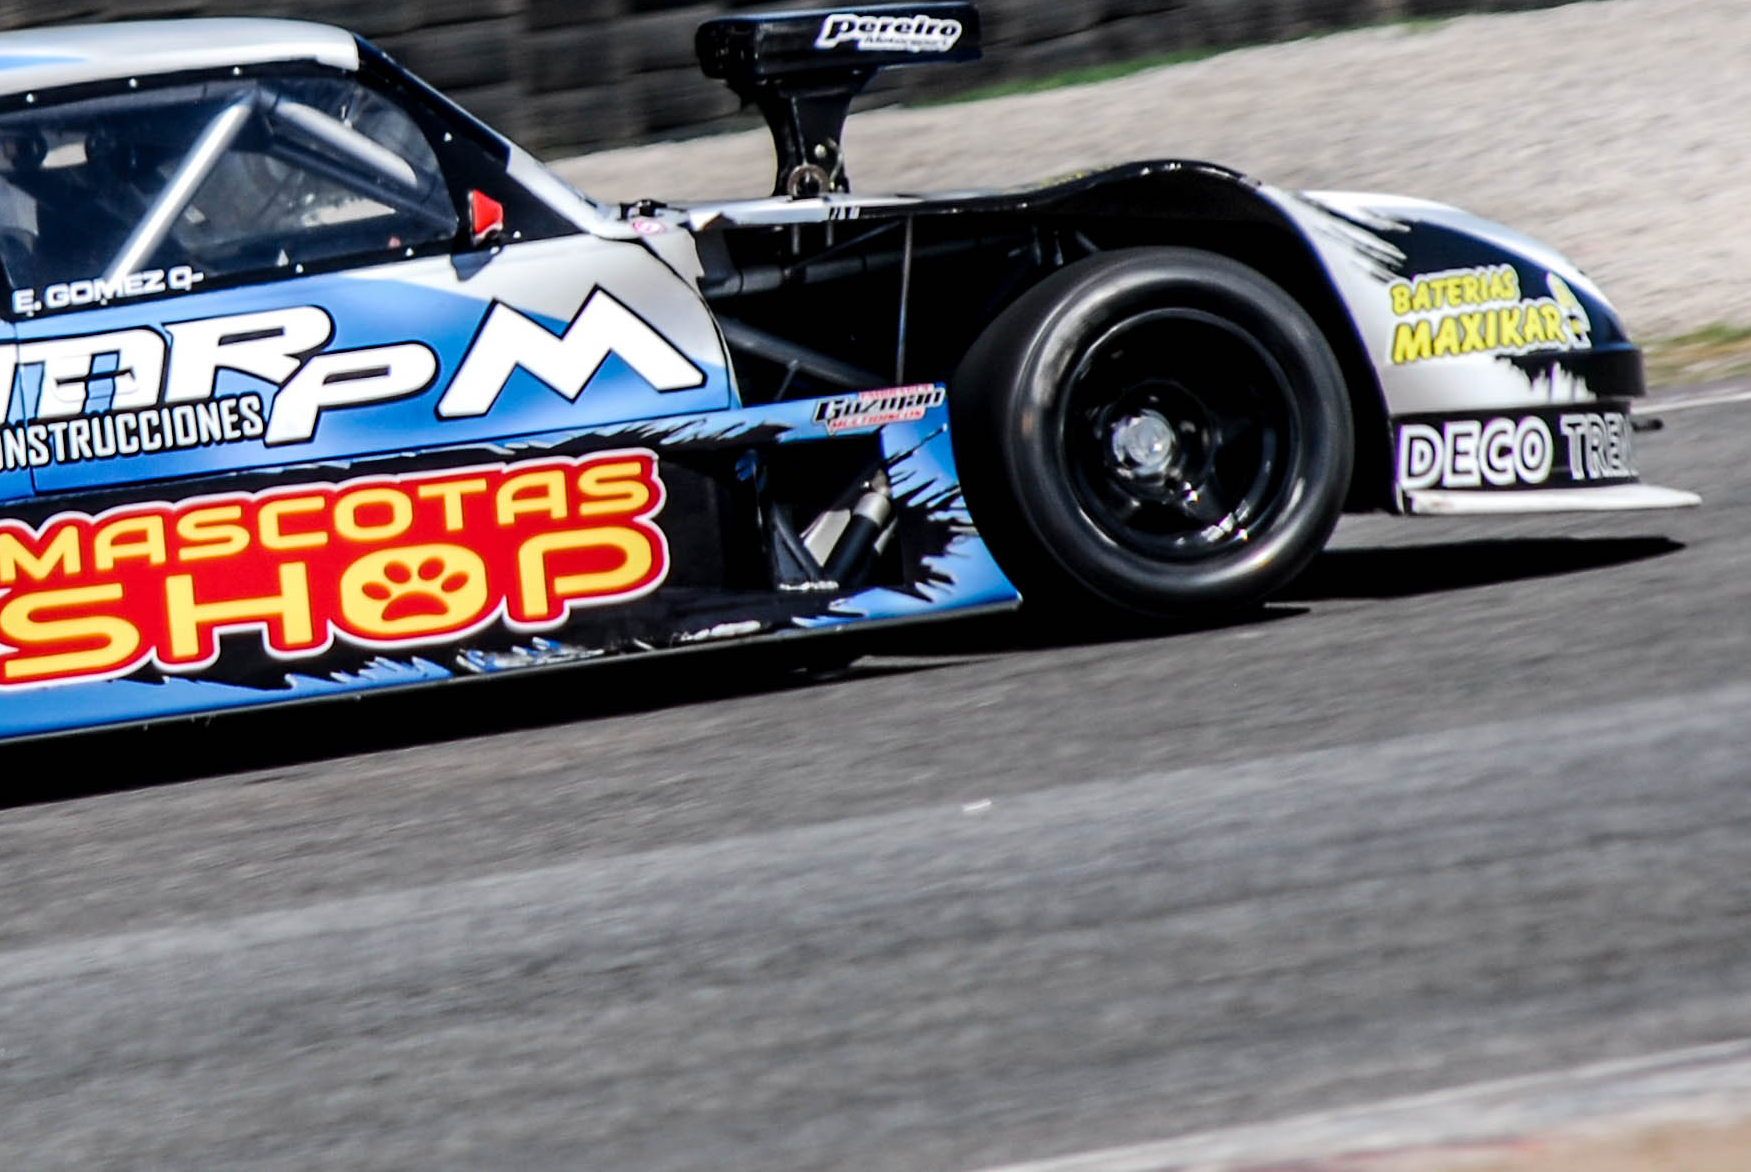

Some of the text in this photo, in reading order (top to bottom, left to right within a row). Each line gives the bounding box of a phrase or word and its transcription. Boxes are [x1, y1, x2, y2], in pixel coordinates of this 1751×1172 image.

[12, 289, 42, 314] E.
[44, 268, 167, 309] GOMEZ
[1390, 268, 1518, 316] BATERIAS
[1391, 302, 1567, 365] MAXIKAR
[1399, 416, 1554, 490] DECO
